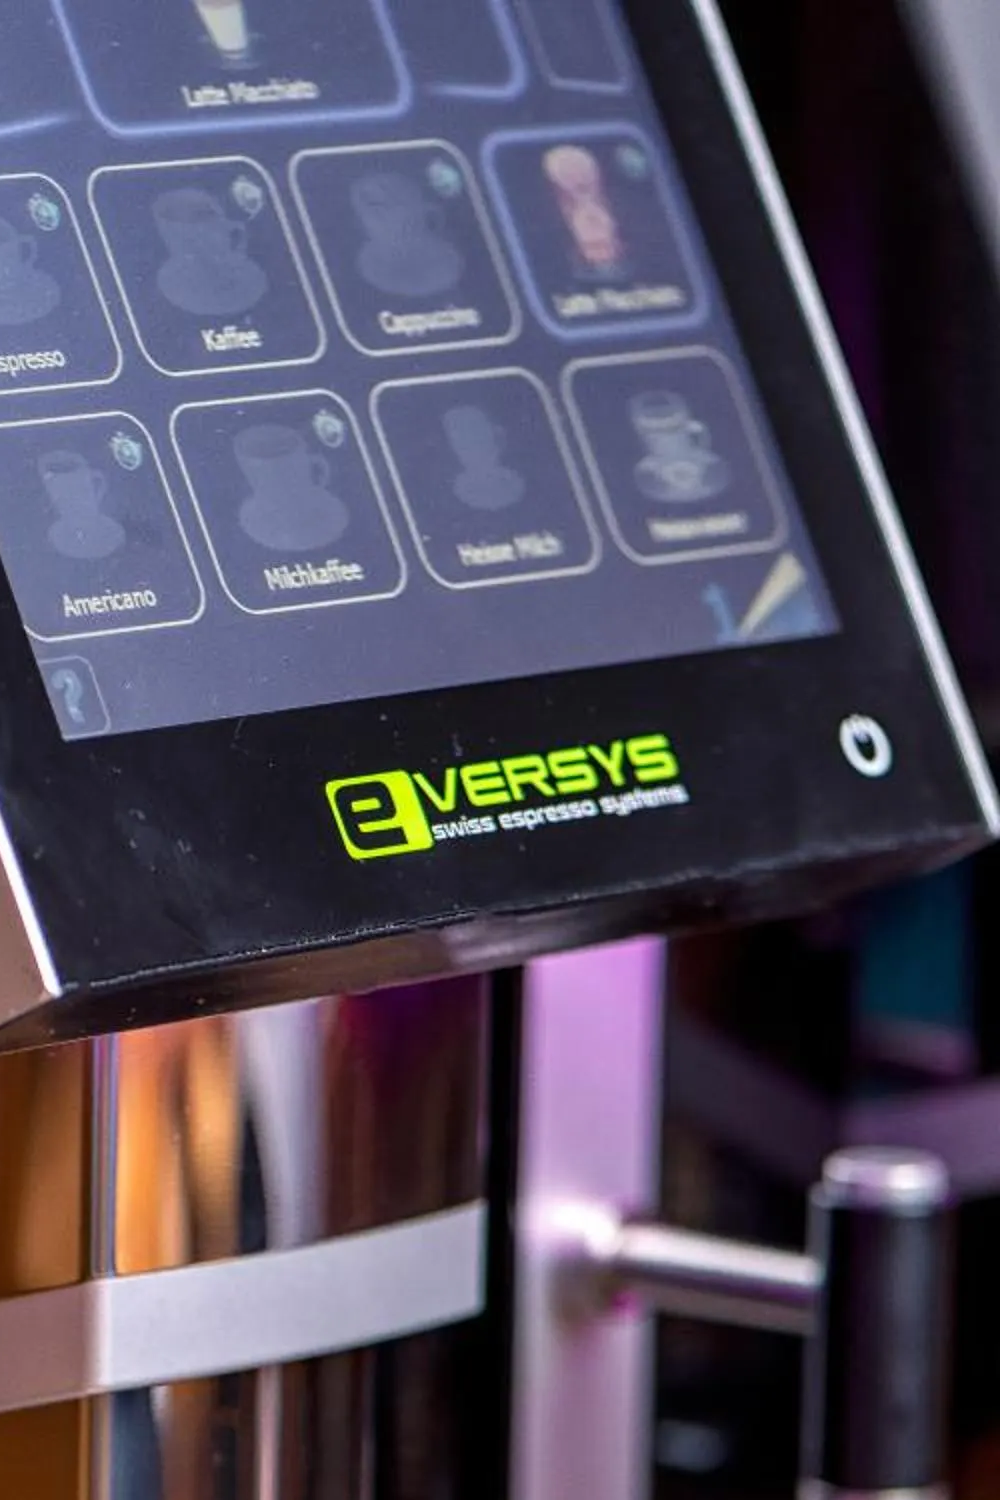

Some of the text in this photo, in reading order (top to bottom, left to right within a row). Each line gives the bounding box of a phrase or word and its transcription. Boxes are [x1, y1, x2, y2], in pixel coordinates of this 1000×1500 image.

[200, 326, 263, 353] Kaffee
[263, 559, 365, 591] Milchkaffee
[62, 588, 158, 618] Americano
[431, 783, 690, 841] swiss espresso systems
